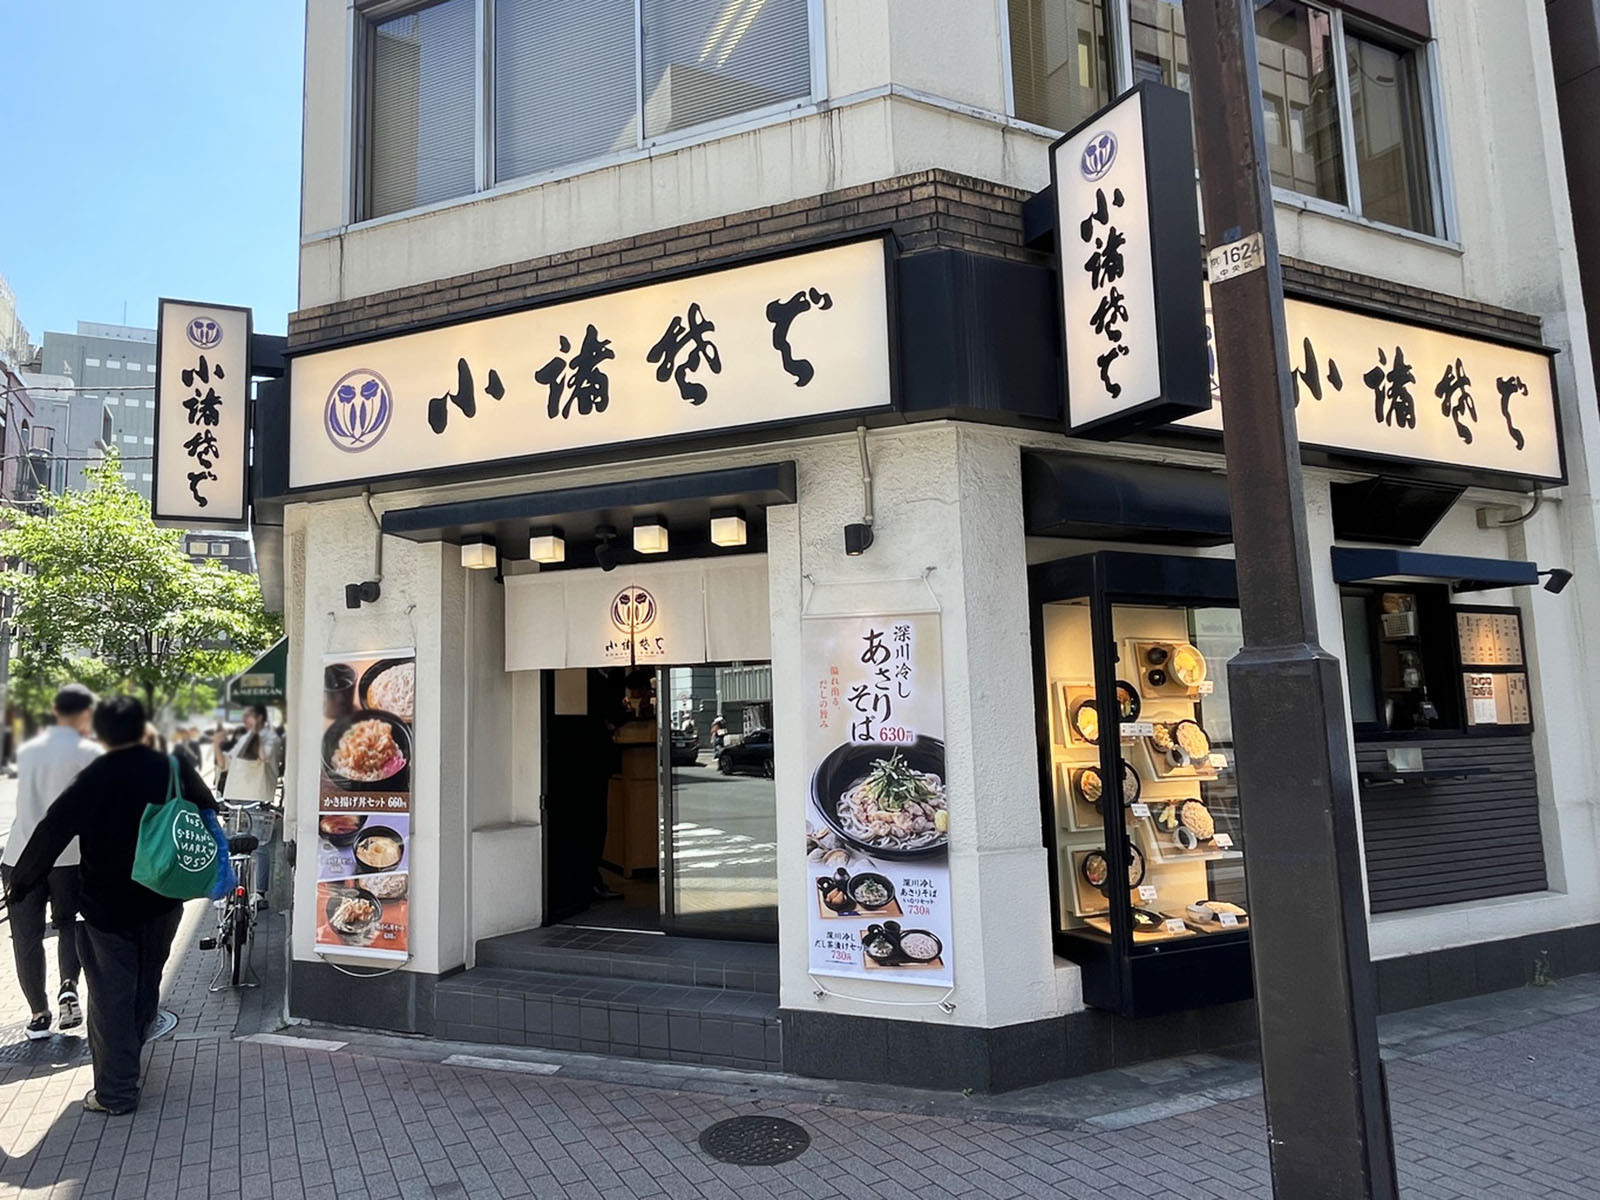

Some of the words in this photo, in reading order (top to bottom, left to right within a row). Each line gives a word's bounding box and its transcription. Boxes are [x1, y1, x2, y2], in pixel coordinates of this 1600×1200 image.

[1222, 239, 1261, 265] 1624
[893, 625, 912, 699] 深川冷し
[860, 628, 891, 723] あさり
[847, 684, 876, 741] そば
[879, 727, 914, 742] 630円
[323, 796, 386, 808] かき揚げ丼セット
[902, 878, 934, 888] 深川冷し
[900, 888, 937, 898] あさりそば
[826, 931, 856, 942] 深川冷し
